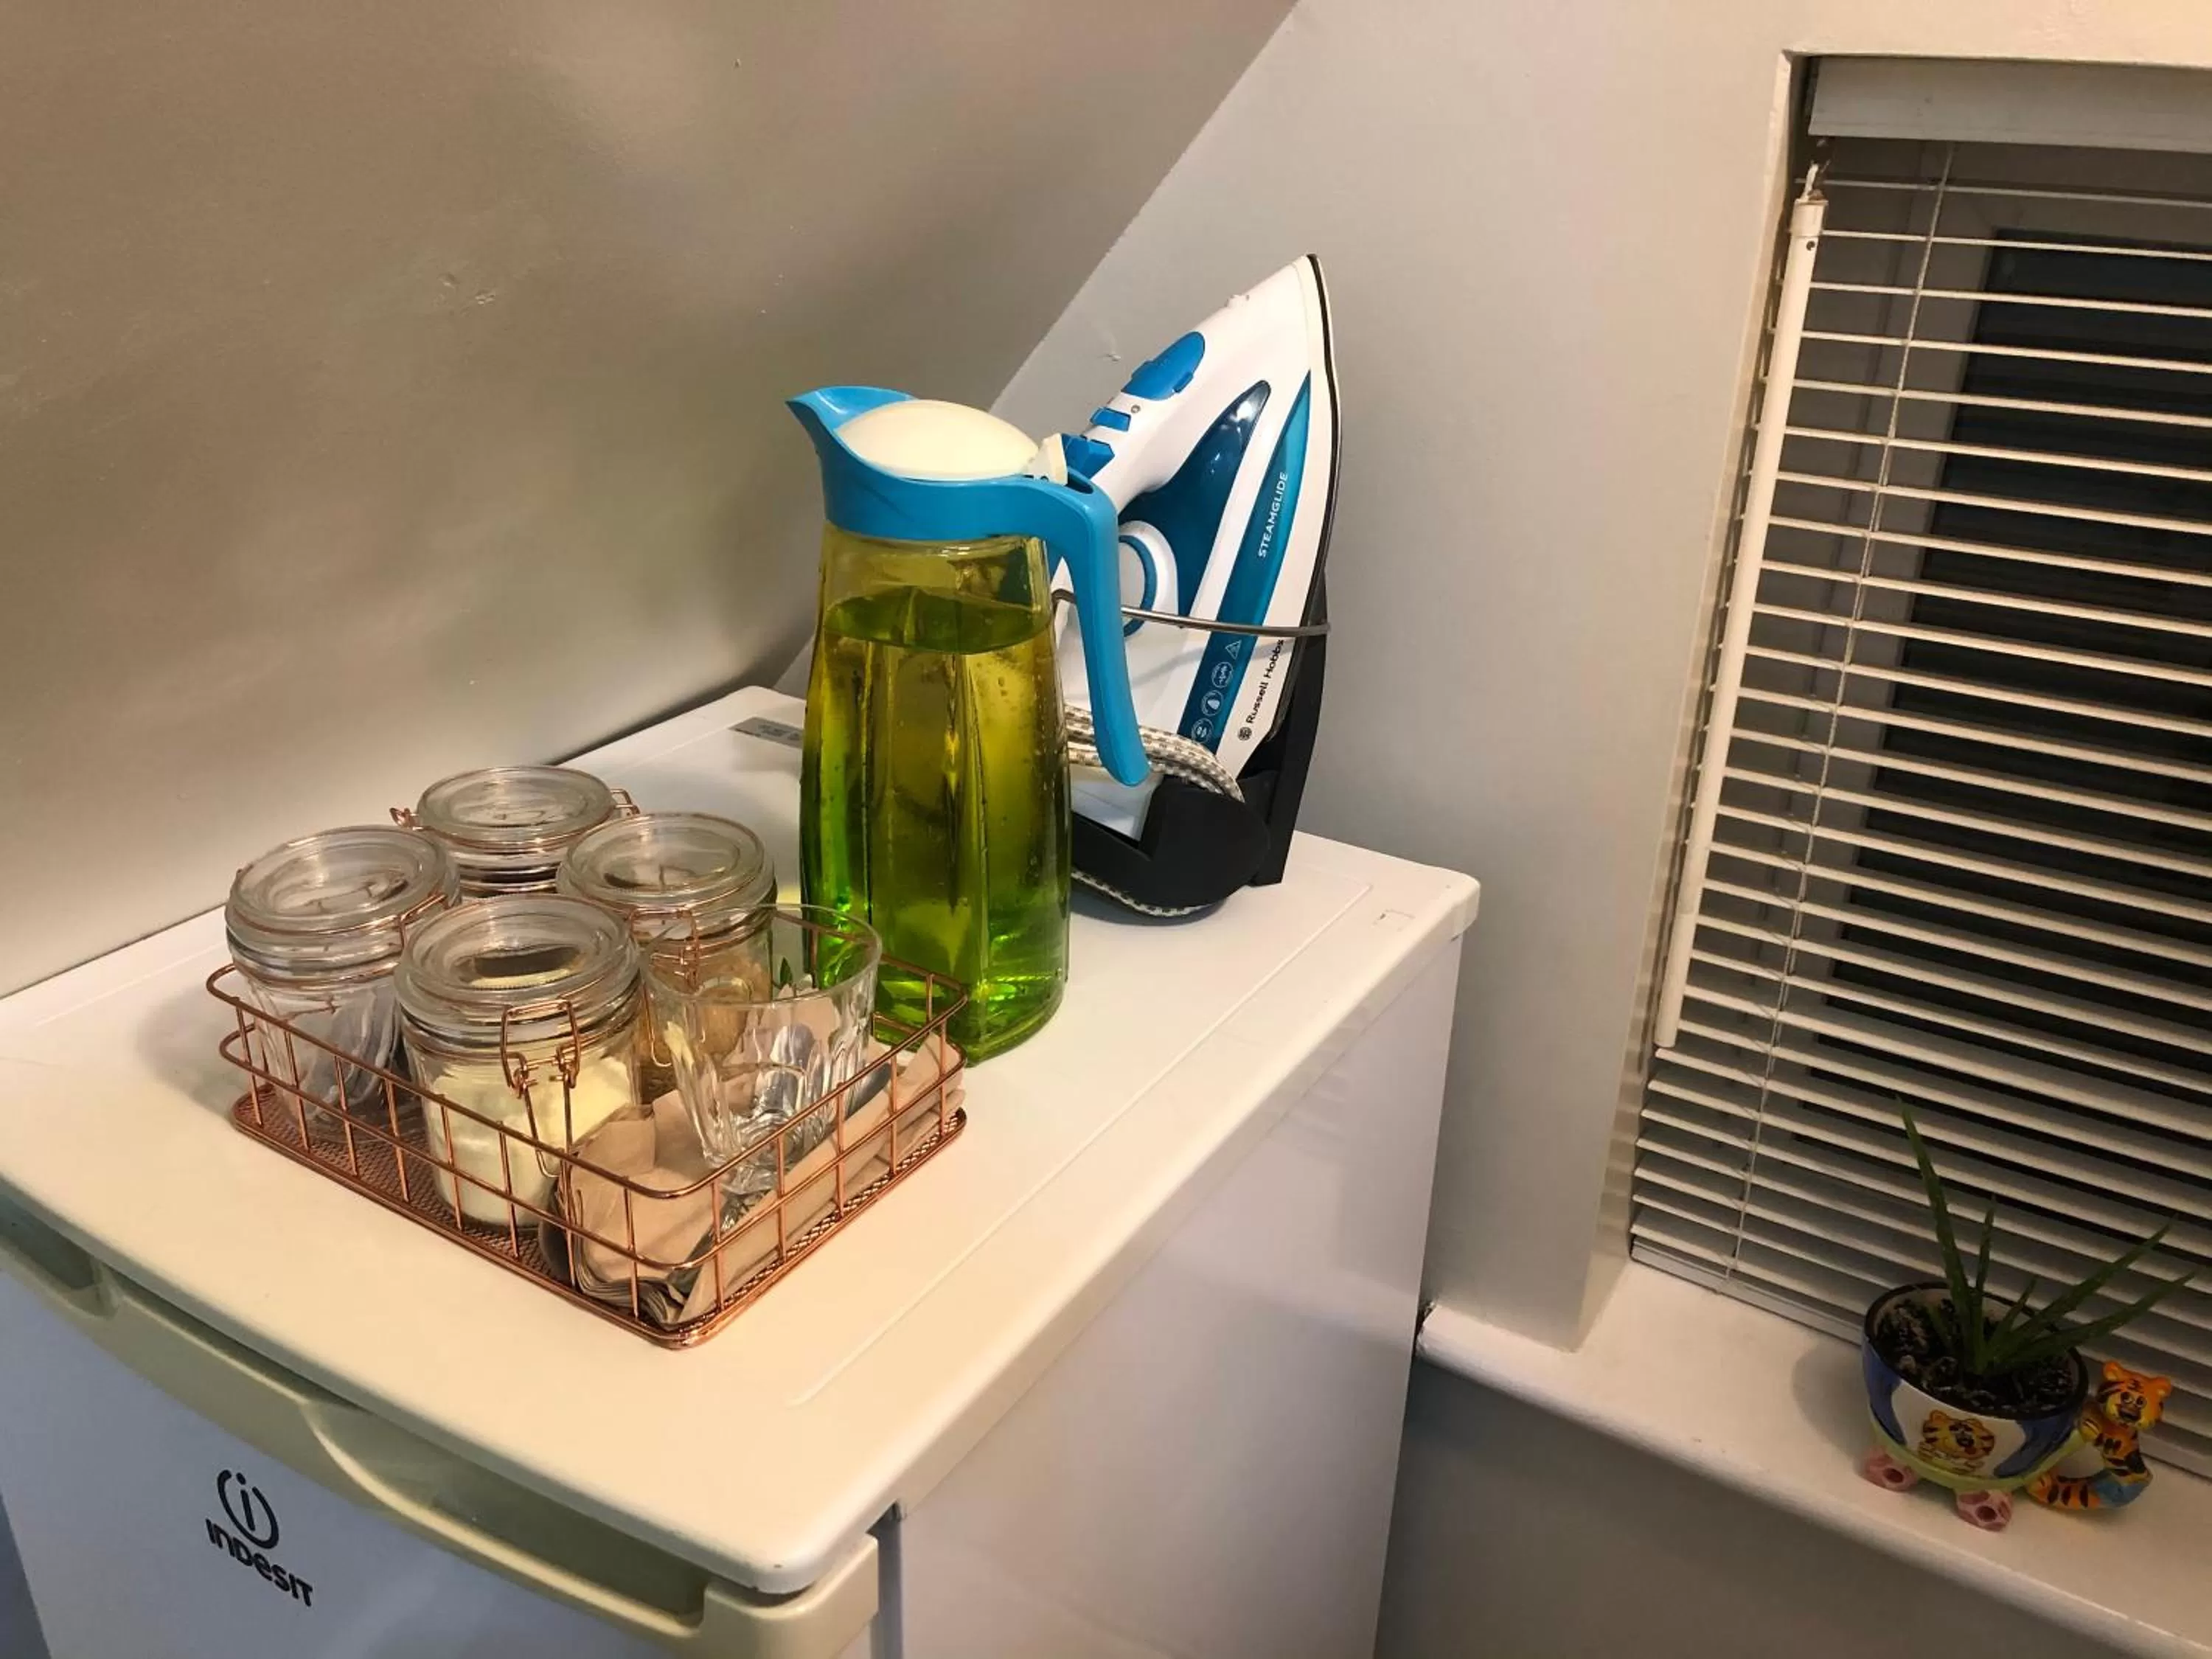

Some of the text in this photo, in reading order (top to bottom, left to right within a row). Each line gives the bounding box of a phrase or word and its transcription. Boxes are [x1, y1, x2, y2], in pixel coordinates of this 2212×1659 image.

[1258, 472, 1288, 558] STEAMGLIDE
[1246, 639, 1284, 723] Russell Hobbs
